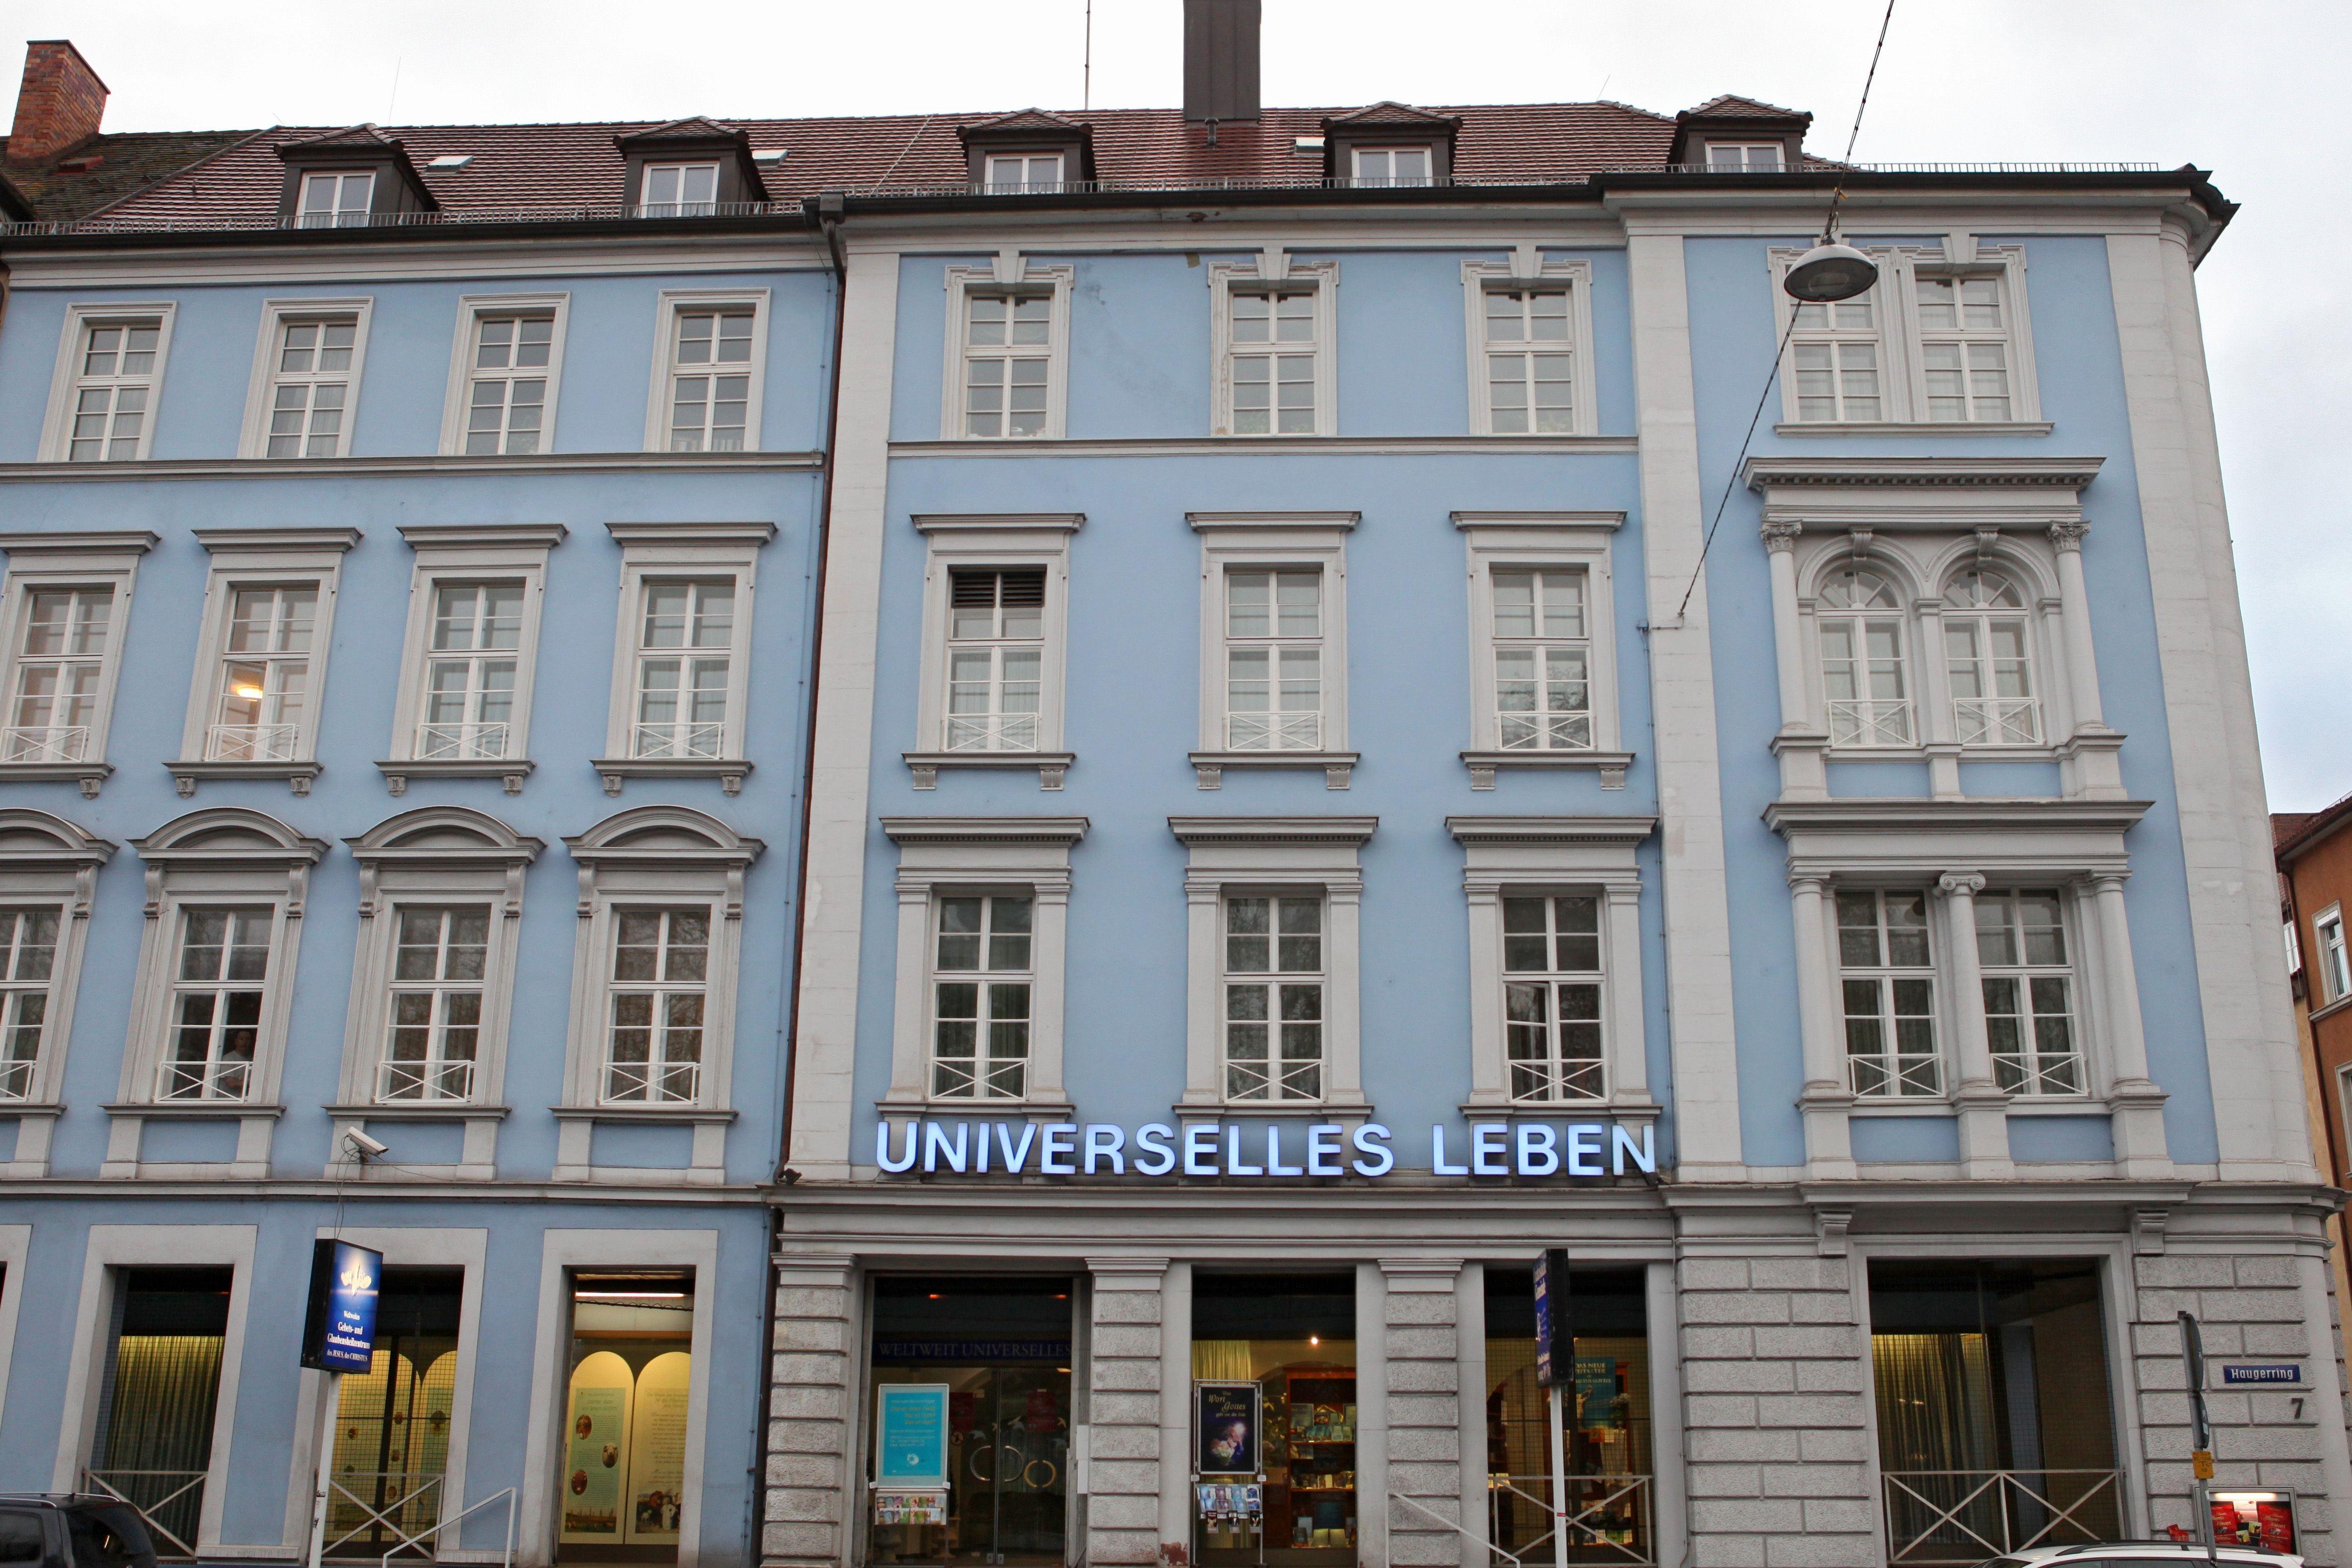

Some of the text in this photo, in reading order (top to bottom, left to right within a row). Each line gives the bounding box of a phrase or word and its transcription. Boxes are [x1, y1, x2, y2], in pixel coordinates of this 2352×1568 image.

[875, 1121, 1656, 1177] UNIVERSELLES LEBEN
[338, 1321, 363, 1335] Gebets- und
[327, 1333, 371, 1349] Glaubensheilzentrum
[879, 1343, 1071, 1356] WELTWEIT UNIVERSELLES
[350, 1353, 368, 1362] CHRISTUS
[2230, 1368, 2293, 1380] Haugerring
[1208, 1394, 1225, 1403] Wort
[1222, 1401, 1246, 1412] Gottes
[2291, 1398, 2304, 1419] 7
